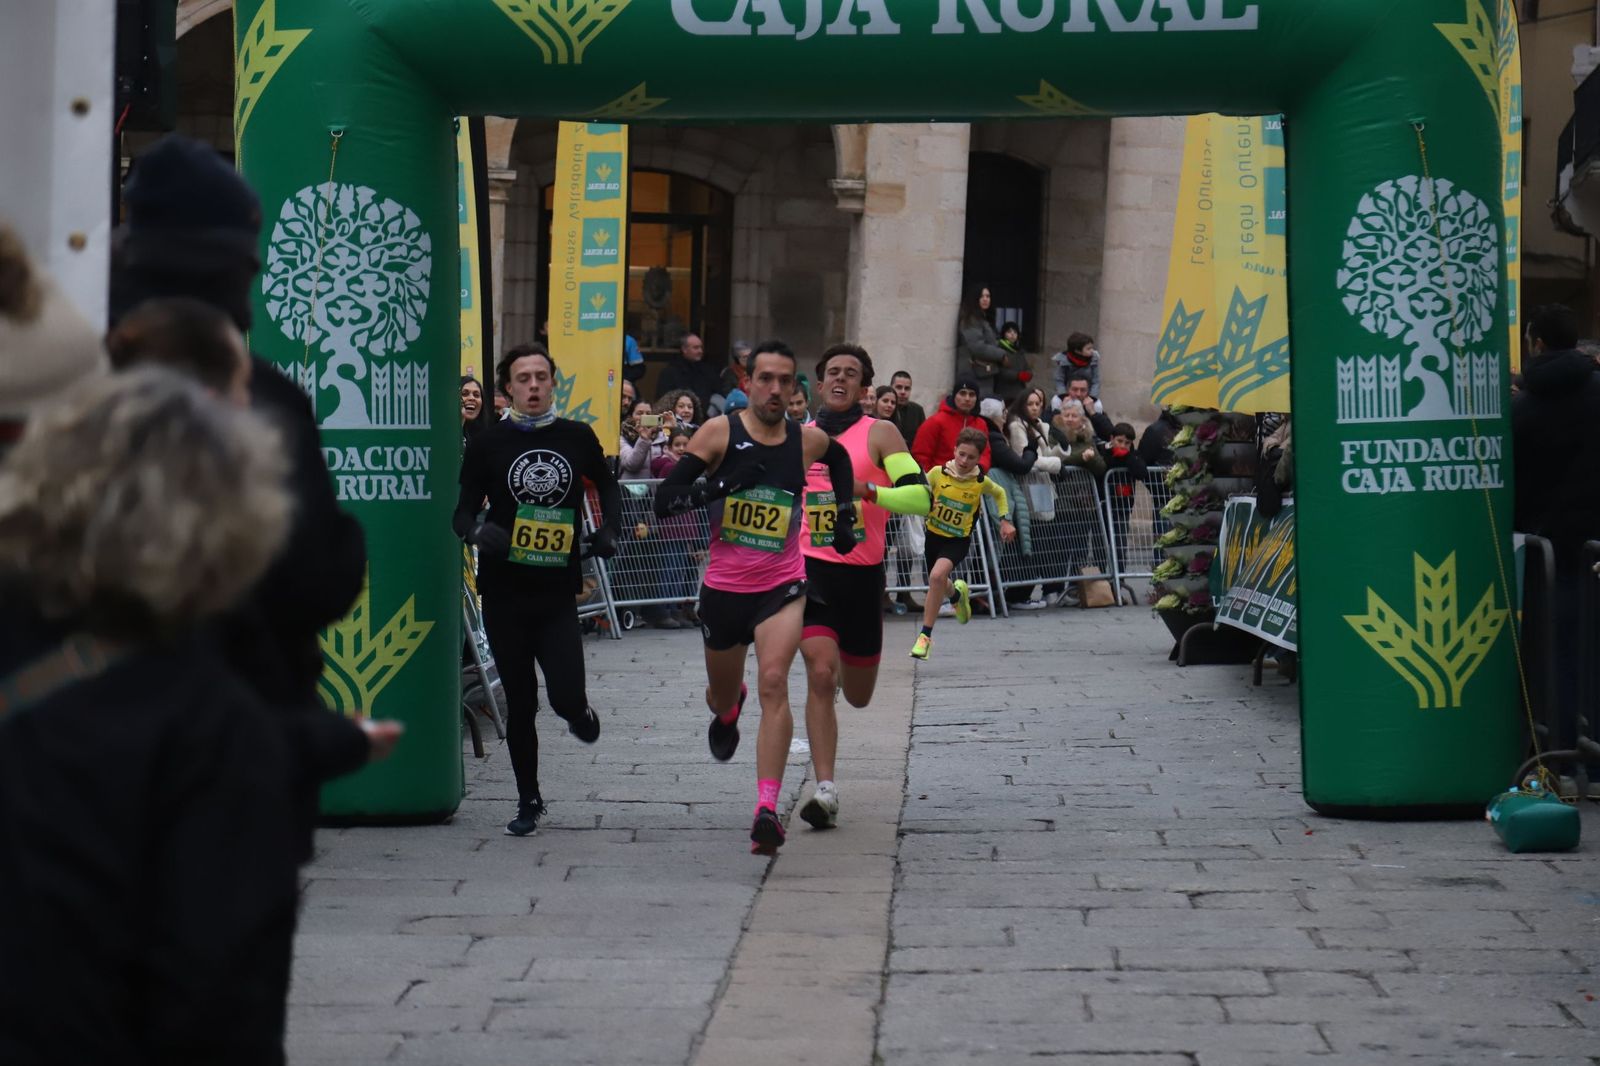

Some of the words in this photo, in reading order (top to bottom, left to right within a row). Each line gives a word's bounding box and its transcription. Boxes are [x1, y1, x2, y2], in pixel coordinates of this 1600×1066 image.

[319, 446, 432, 471] DACION
[1341, 436, 1503, 465] FUNDACION
[335, 474, 432, 502] RURAL
[1342, 467, 1416, 495] CAJA
[1422, 464, 1505, 491] RURAL
[730, 501, 781, 532] 1052
[937, 505, 964, 526] 105
[516, 525, 566, 552] 653
[739, 535, 756, 545] CAJA
[526, 553, 543, 562] CAJA
